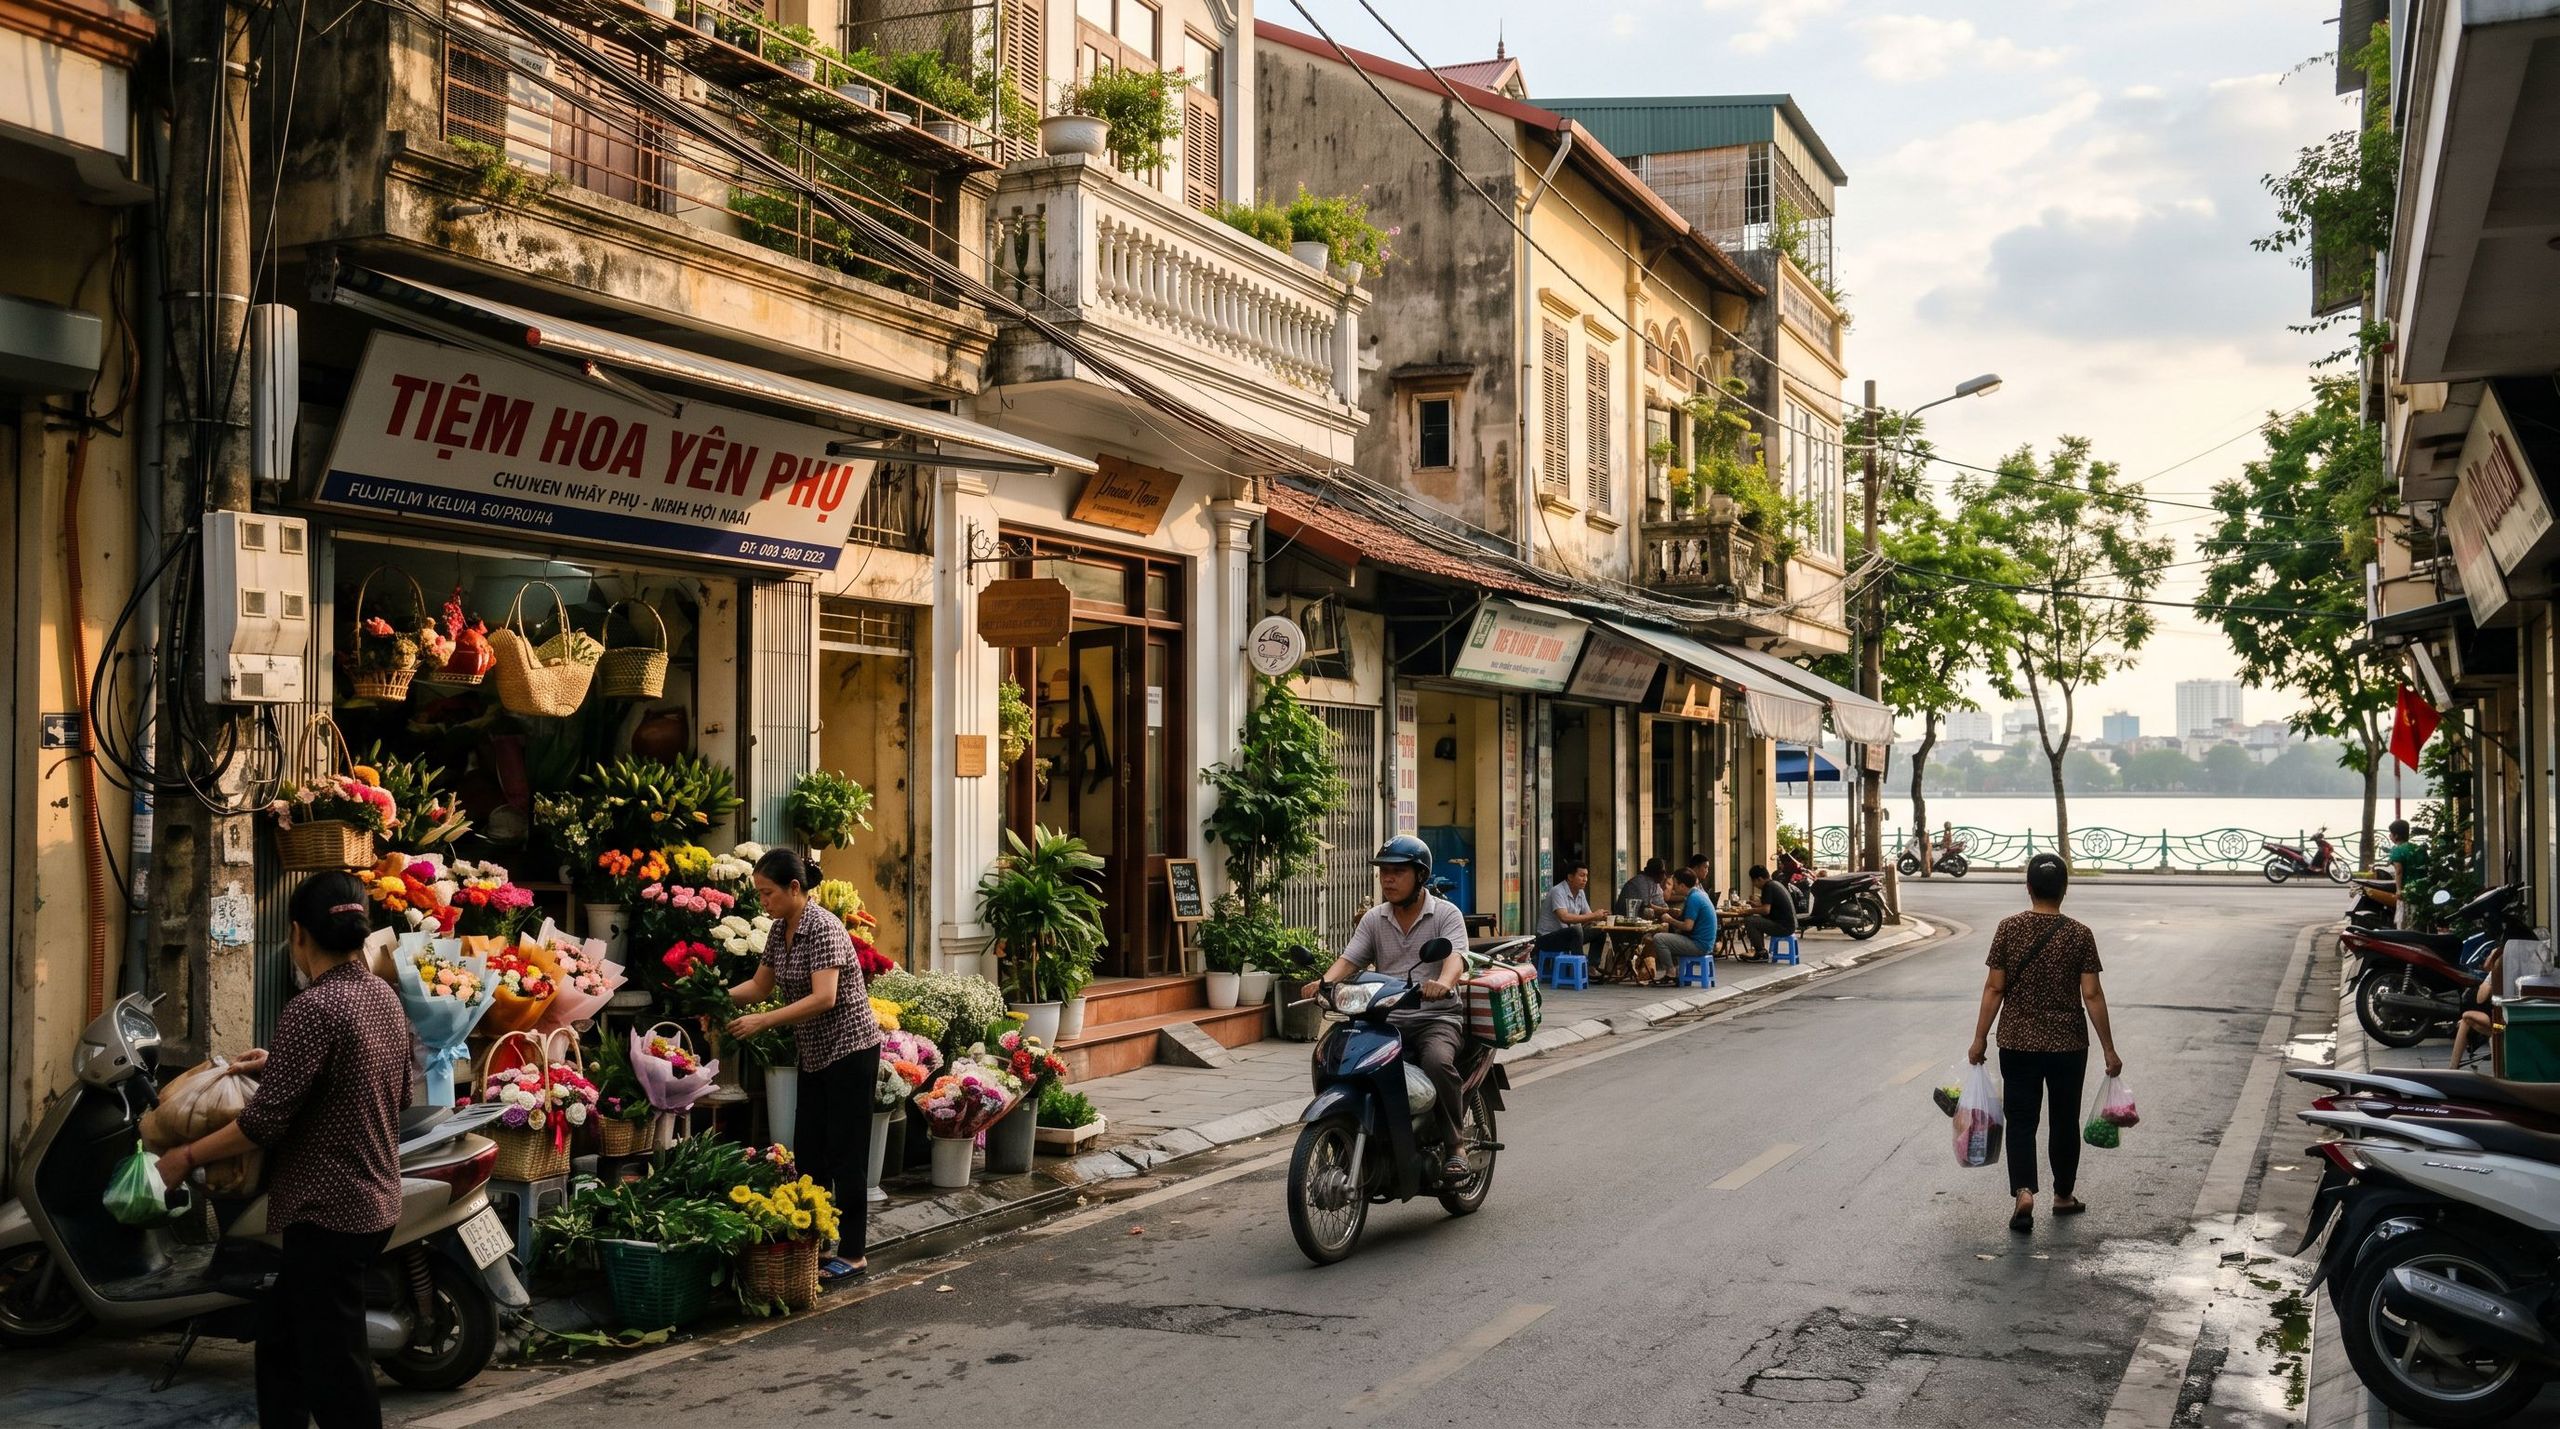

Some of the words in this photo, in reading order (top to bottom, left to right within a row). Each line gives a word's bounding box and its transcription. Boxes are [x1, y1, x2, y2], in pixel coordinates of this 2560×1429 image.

[386, 373, 534, 460] TIỆM
[539, 407, 648, 479] HOA
[664, 425, 759, 497] YÊN
[760, 452, 853, 523] PHỤ
[348, 482, 423, 506] FUJIFILM
[608, 491, 641, 512] PHỤ
